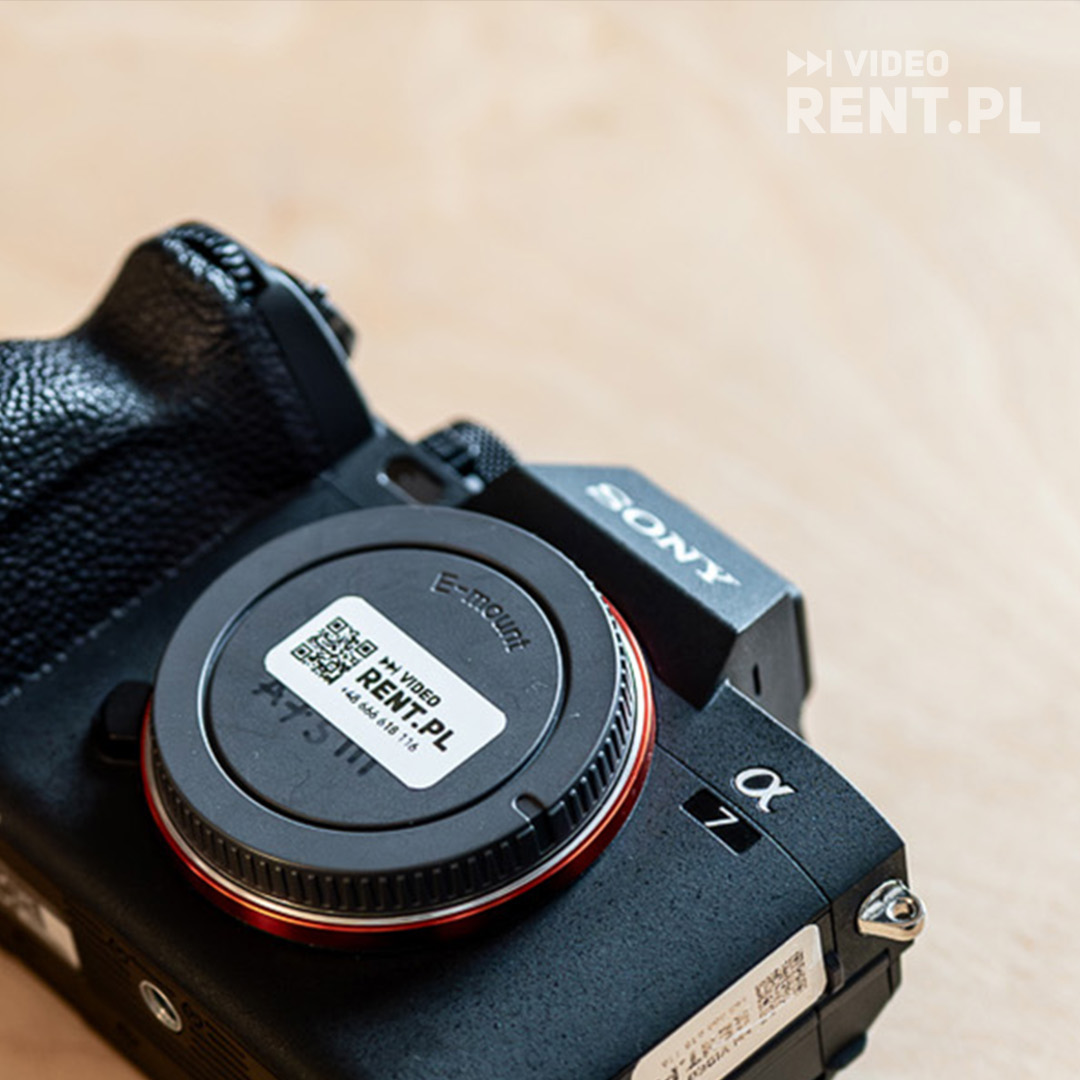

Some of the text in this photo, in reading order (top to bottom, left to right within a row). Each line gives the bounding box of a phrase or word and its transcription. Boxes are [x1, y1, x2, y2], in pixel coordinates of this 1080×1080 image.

[585, 482, 742, 587] SONY
[430, 571, 531, 654] E-mount
[356, 667, 455, 753] RENT.PL
[400, 671, 441, 708] VIDEO
[376, 718, 400, 736] 618
[398, 733, 419, 753] 116
[704, 806, 740, 828] 7
